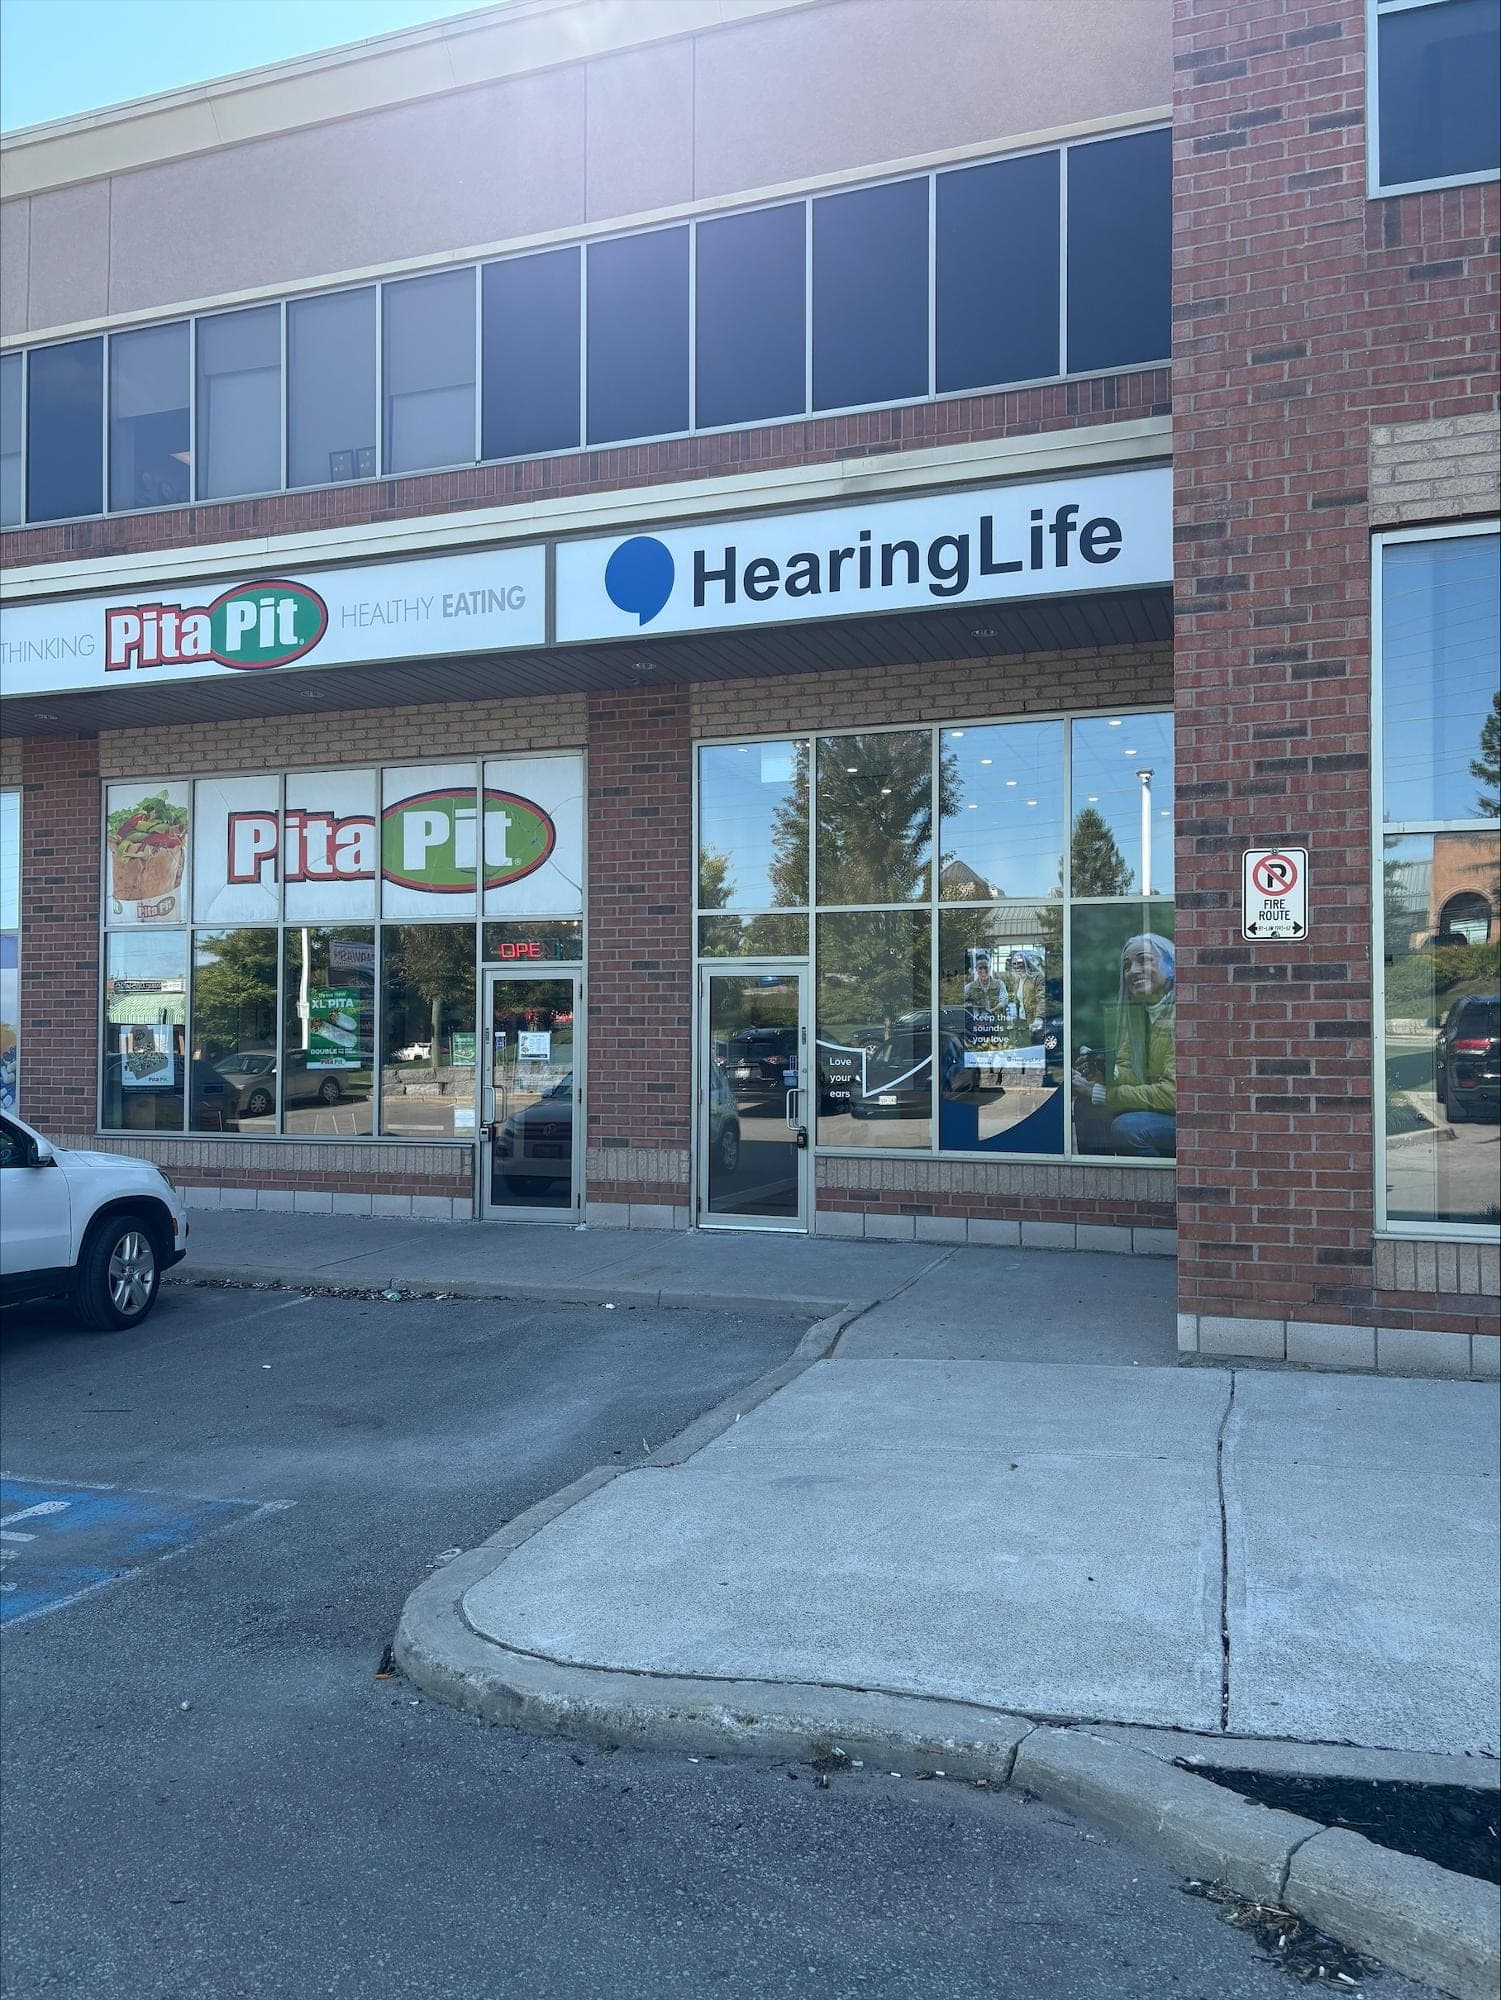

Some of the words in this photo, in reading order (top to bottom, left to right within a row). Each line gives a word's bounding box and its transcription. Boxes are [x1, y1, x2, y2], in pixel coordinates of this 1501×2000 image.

[693, 503, 1124, 607] HearingLife
[0, 633, 96, 665] THINKING
[110, 603, 213, 666] Pita
[225, 597, 300, 651] Pit
[340, 595, 435, 629] HEALTHY
[442, 584, 527, 619] EATING
[233, 817, 376, 878] Pita
[403, 809, 513, 871] Pit
[137, 905, 158, 917] Pita
[159, 898, 173, 913] Pit
[1263, 899, 1286, 910] FIRE
[1259, 910, 1291, 921] ROUTE
[311, 999, 327, 1009] XL
[328, 998, 354, 1008] PITA
[973, 1014, 995, 1023] Keep
[972, 1037, 989, 1045] you
[990, 1036, 1010, 1044] love
[829, 1057, 852, 1066] Love
[829, 1074, 852, 1084] your
[829, 1090, 851, 1098] ears
